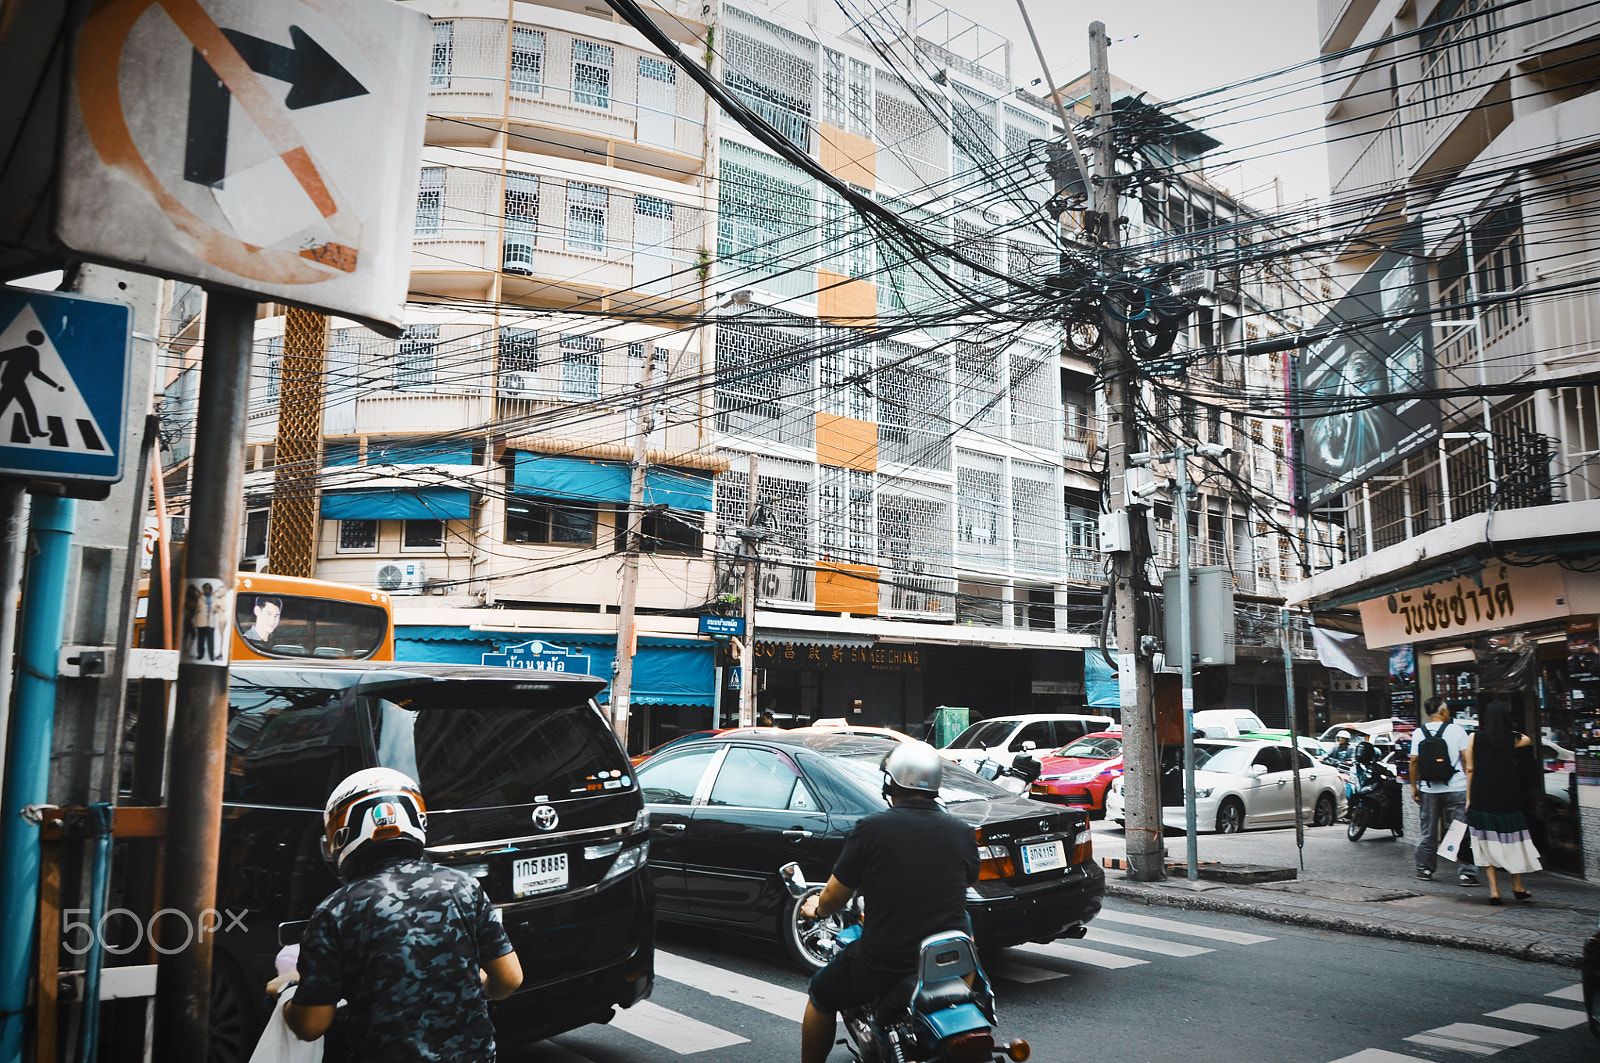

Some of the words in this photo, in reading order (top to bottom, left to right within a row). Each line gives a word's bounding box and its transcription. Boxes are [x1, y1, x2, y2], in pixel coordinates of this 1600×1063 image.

[1399, 566, 1514, 635] วันชัยซาวด์
[506, 655, 565, 672] บ้านหม้อ
[851, 648, 866, 662] SIN
[888, 649, 919, 665] CHIANG
[541, 855, 565, 873] 8885
